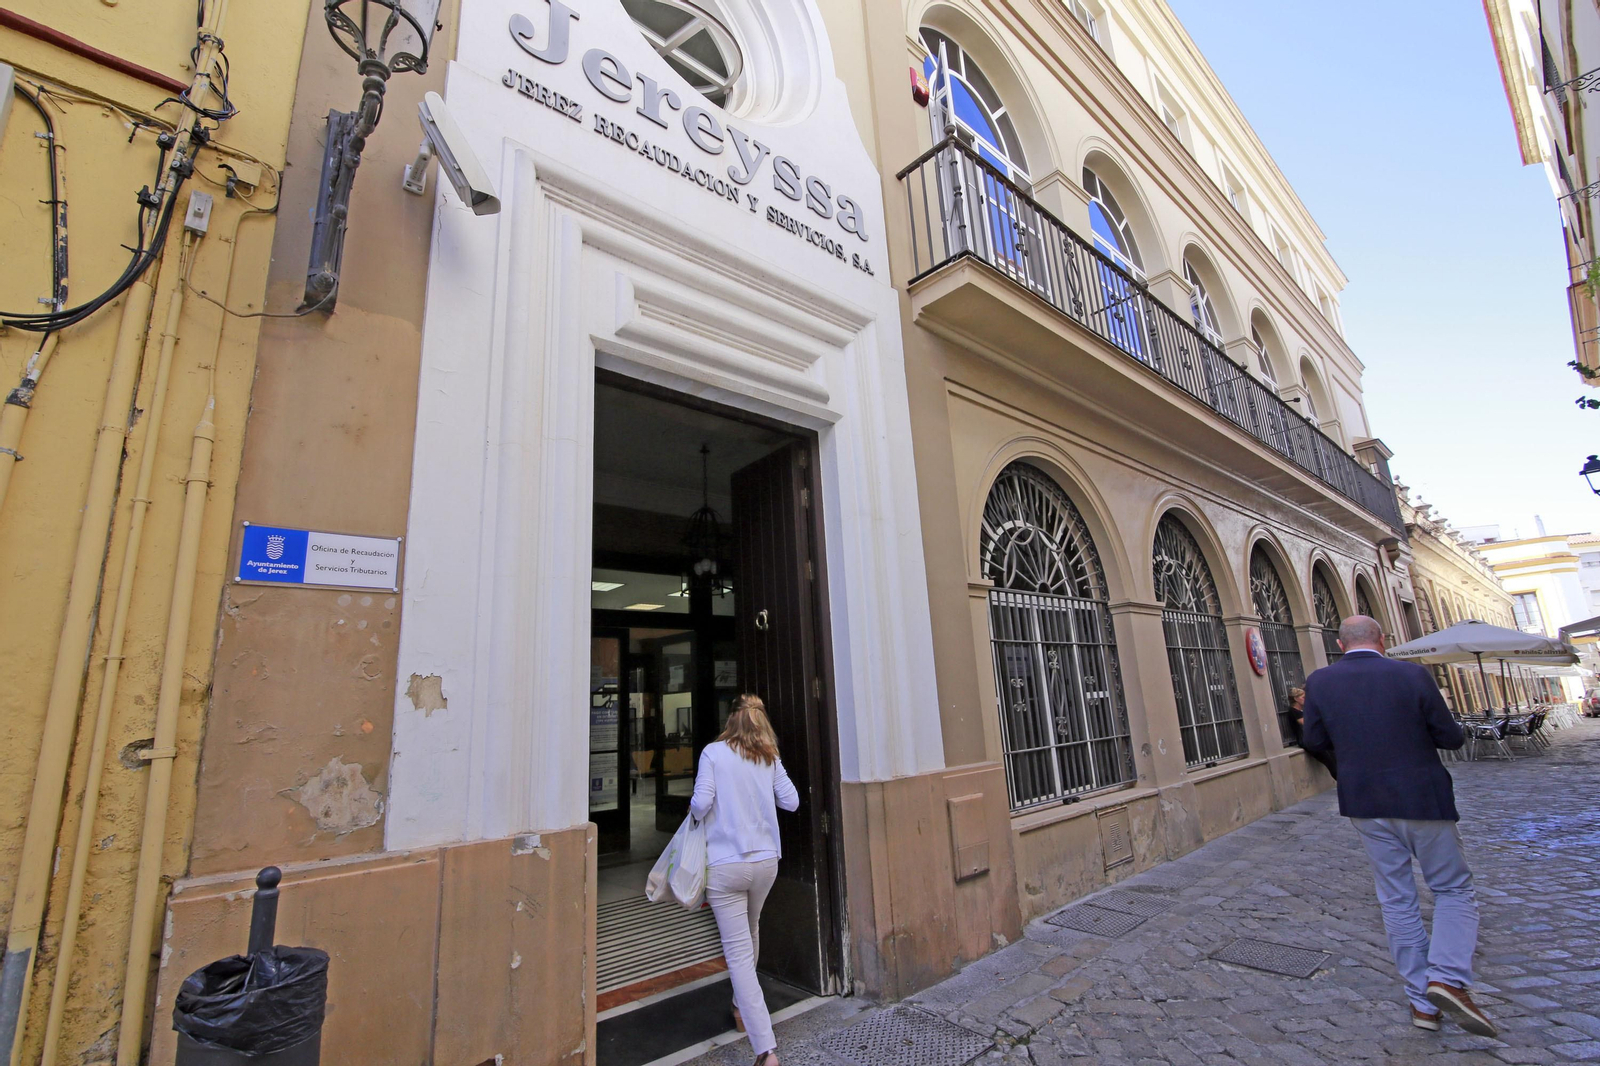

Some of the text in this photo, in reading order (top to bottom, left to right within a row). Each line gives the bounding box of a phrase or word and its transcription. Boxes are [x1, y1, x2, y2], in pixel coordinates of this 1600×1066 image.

[508, 0, 869, 242] Jereyssa
[502, 68, 583, 124] JEREZ
[593, 113, 740, 204] RECAUDACION
[747, 193, 759, 213] Y
[852, 252, 875, 276] S.A.
[311, 544, 338, 554] Oficina
[351, 549, 395, 558] Recaudación
[247, 560, 299, 570] Ayuntamiento
[315, 563, 388, 576] Servicios Tributarios
